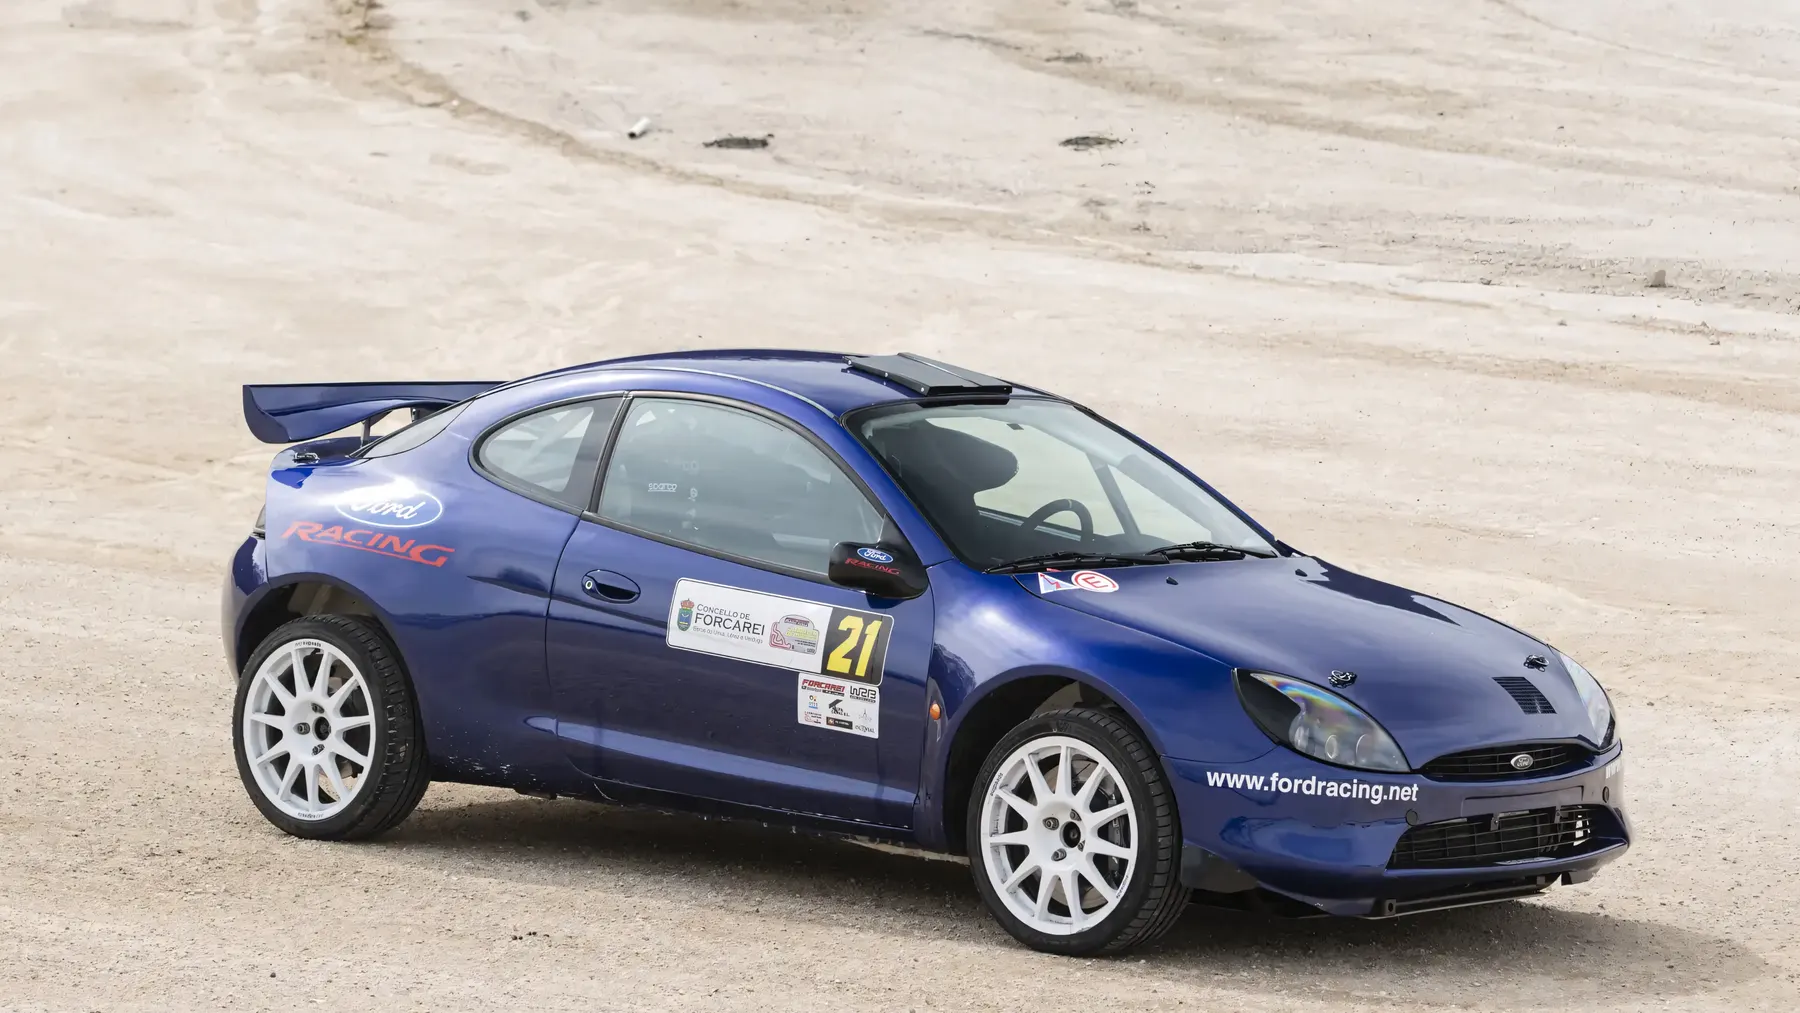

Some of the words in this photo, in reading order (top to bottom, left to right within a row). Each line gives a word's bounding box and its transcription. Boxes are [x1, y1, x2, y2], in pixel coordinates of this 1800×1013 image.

[281, 521, 455, 567] RACING
[864, 549, 887, 560] Ford
[845, 558, 901, 574] RACING
[696, 603, 739, 618] CONCELLO
[739, 612, 750, 620] DE
[694, 612, 765, 636] FORCAREI
[826, 615, 883, 677] 21
[802, 679, 846, 693] FORCAREI
[1206, 771, 1419, 805] www.fordracing.net
